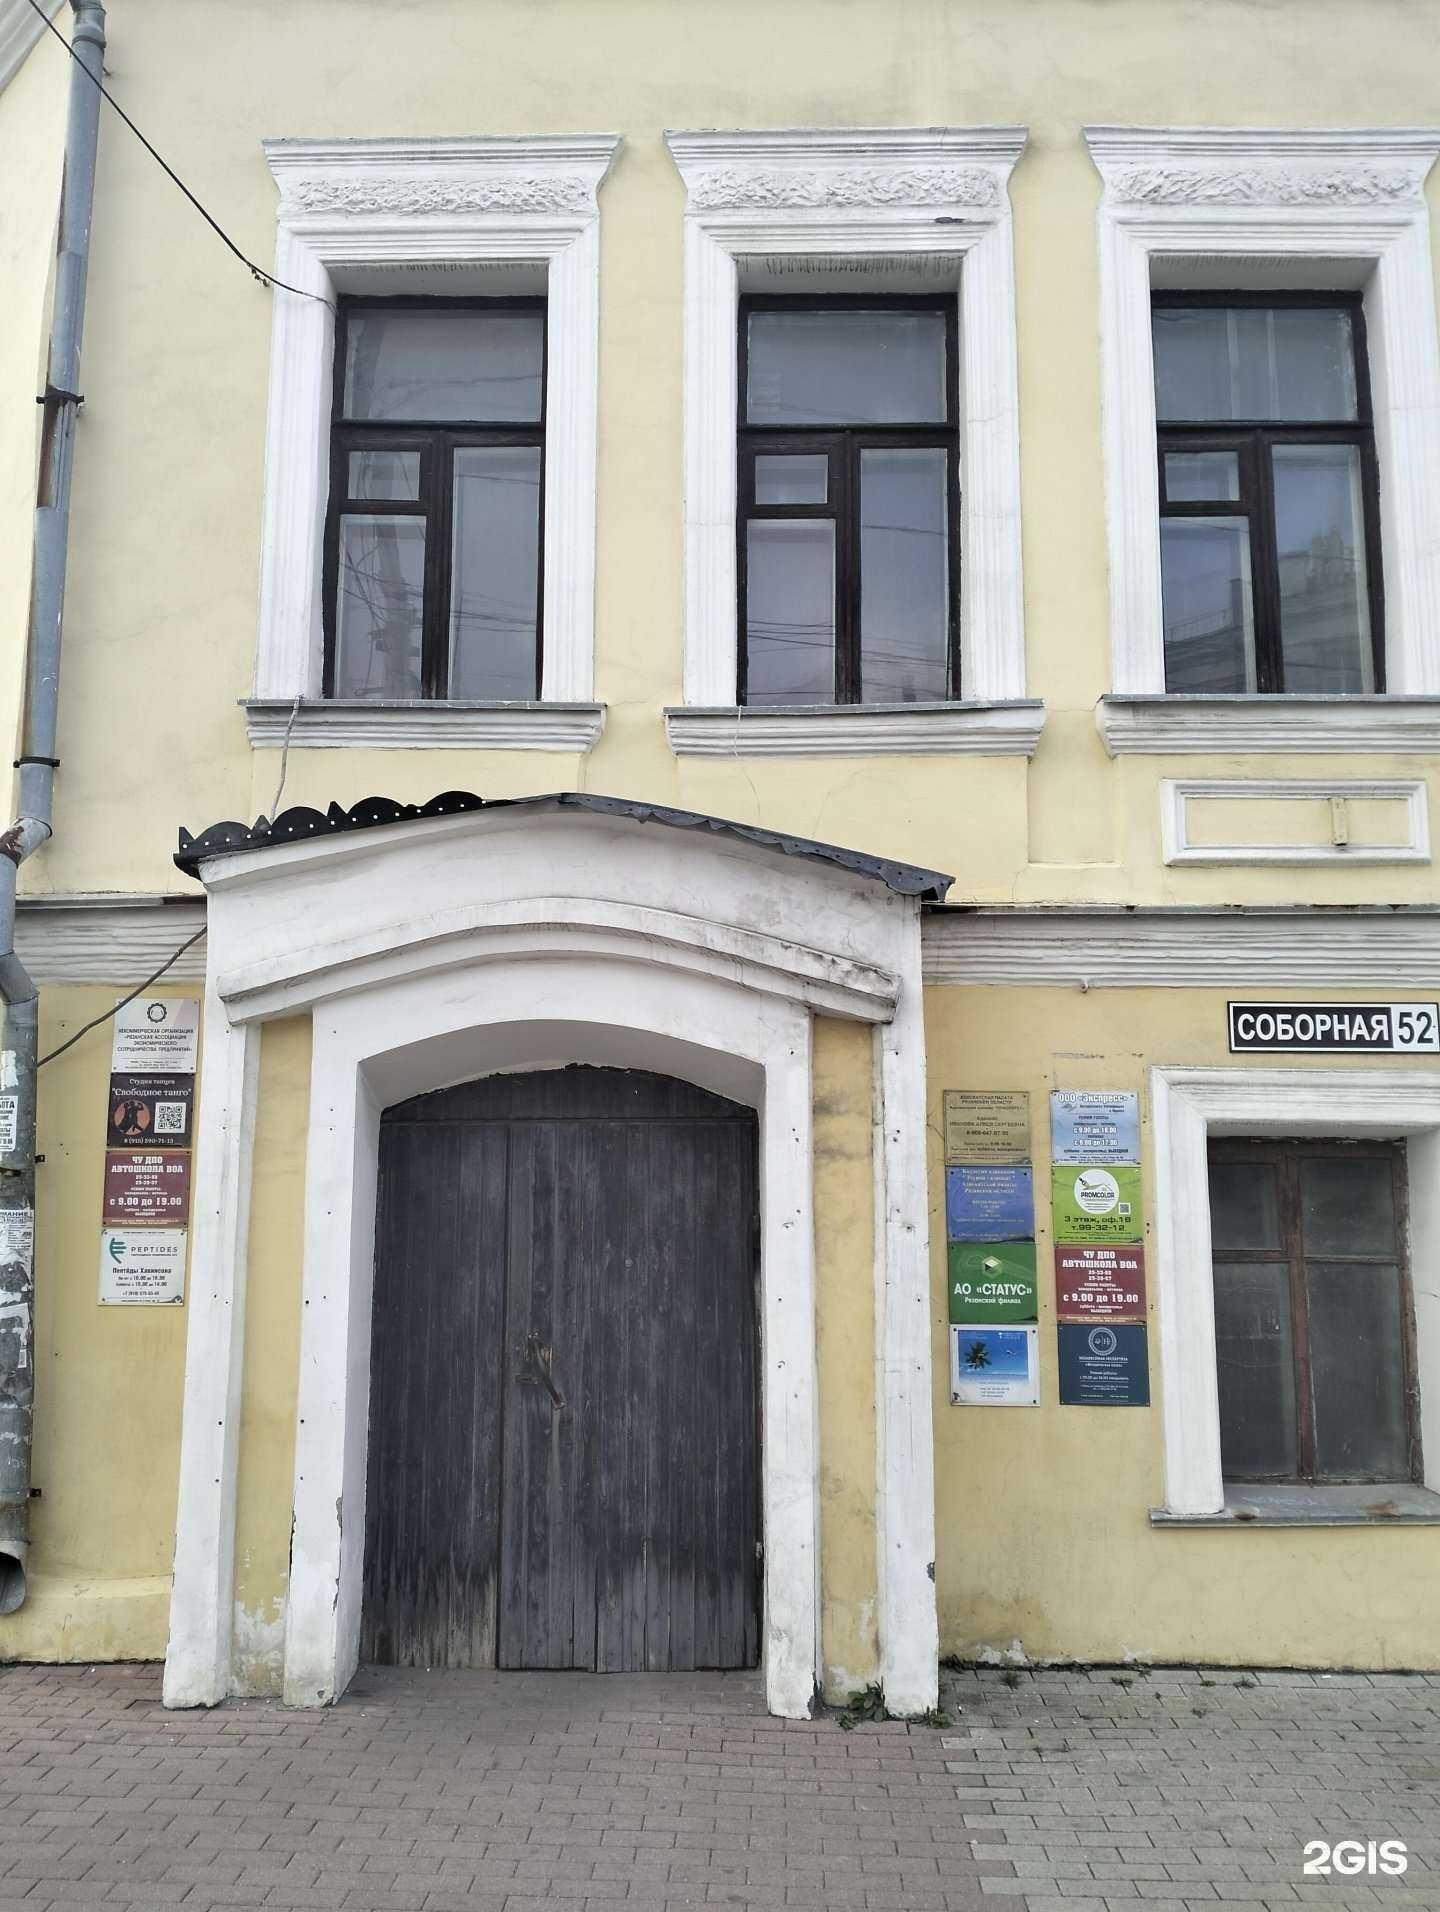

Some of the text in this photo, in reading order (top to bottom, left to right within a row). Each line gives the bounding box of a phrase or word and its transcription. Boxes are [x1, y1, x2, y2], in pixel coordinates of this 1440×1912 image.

[1237, 1012, 1434, 1044] СОБОРНАЯ 52
[1058, 1093, 1076, 1102] ООО
[132, 1156, 163, 1164] ЧУ ДПО
[111, 1165, 183, 1173] АВТОШКОЛА ВОА
[118, 1197, 139, 1206] 9.00
[141, 1198, 153, 1206] до
[156, 1197, 182, 1206] 19.00
[1083, 1251, 1116, 1260] ЧУ ДПО
[1062, 1260, 1138, 1269] АВТОШКОЛА ВОА
[954, 1283, 1032, 1296] АО «СТАТУС»
[1071, 1293, 1094, 1302] 9.00
[1096, 1295, 1108, 1303] до
[1112, 1294, 1139, 1303] 19.00
